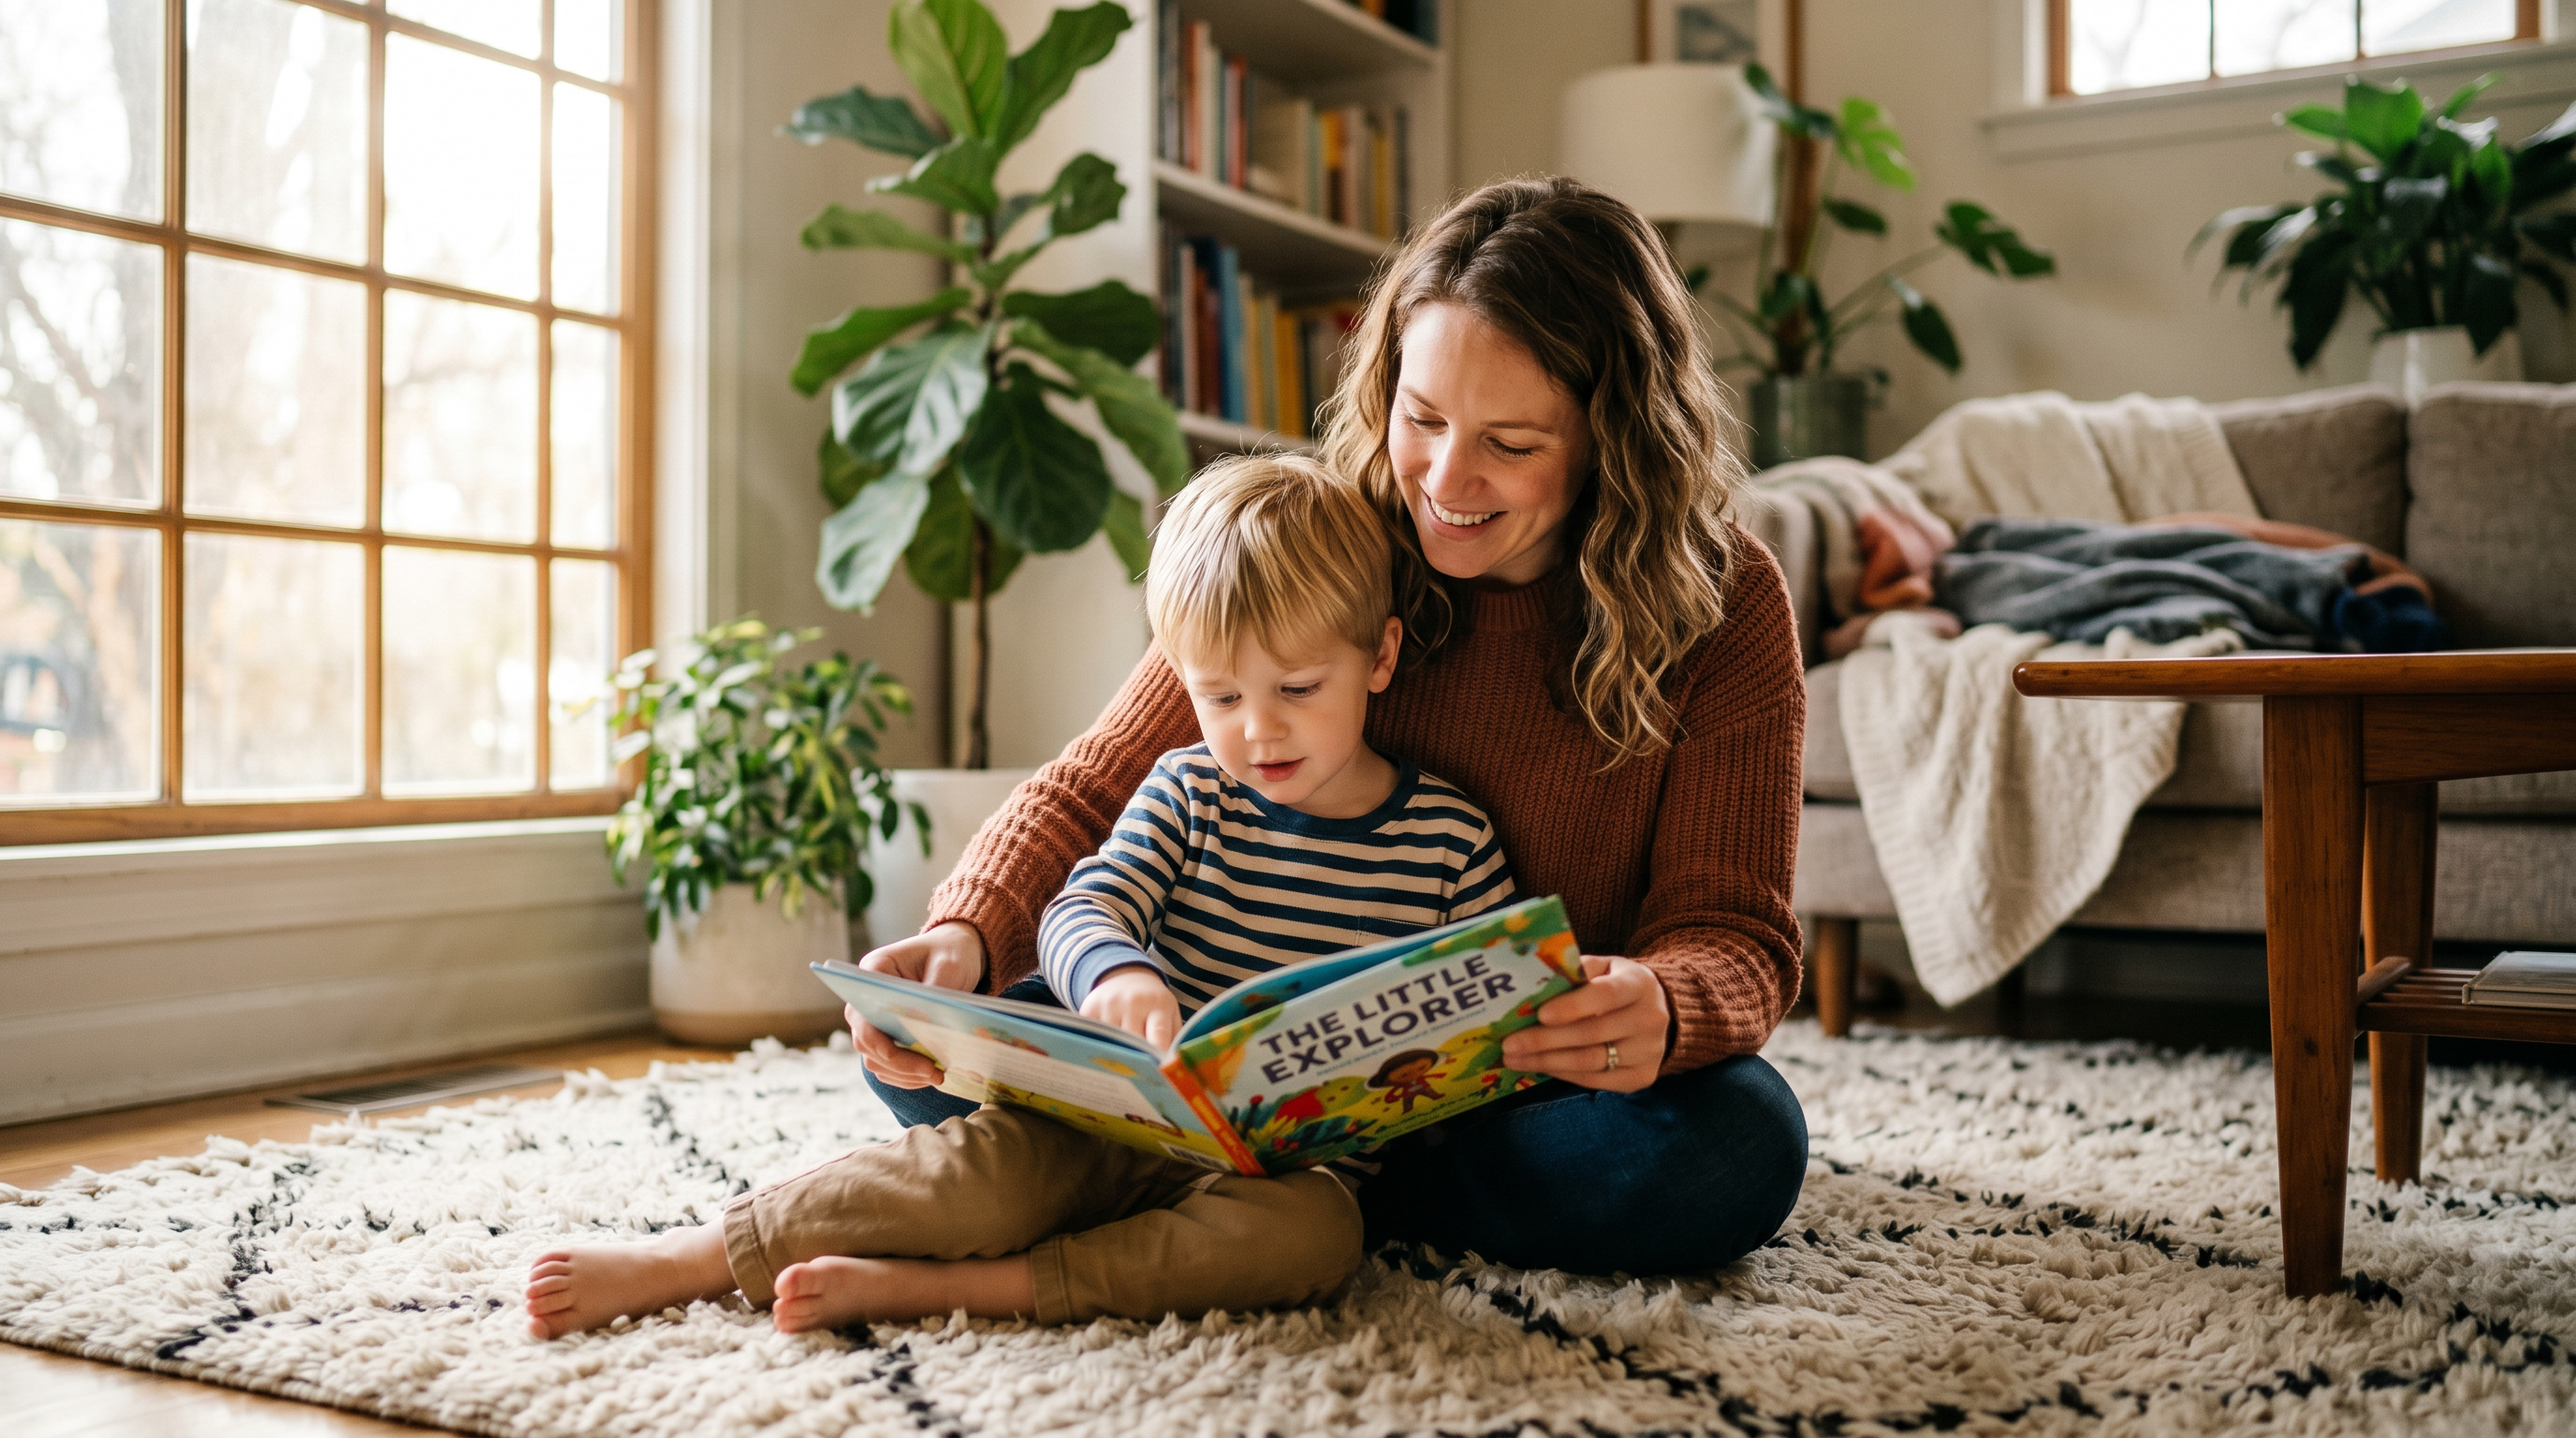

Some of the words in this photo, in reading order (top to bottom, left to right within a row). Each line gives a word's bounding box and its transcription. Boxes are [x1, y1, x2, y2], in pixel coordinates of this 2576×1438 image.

[1260, 1011, 1345, 1054] THE
[1353, 954, 1490, 1020] LITTLE
[1261, 973, 1516, 1084] EXPLORER
